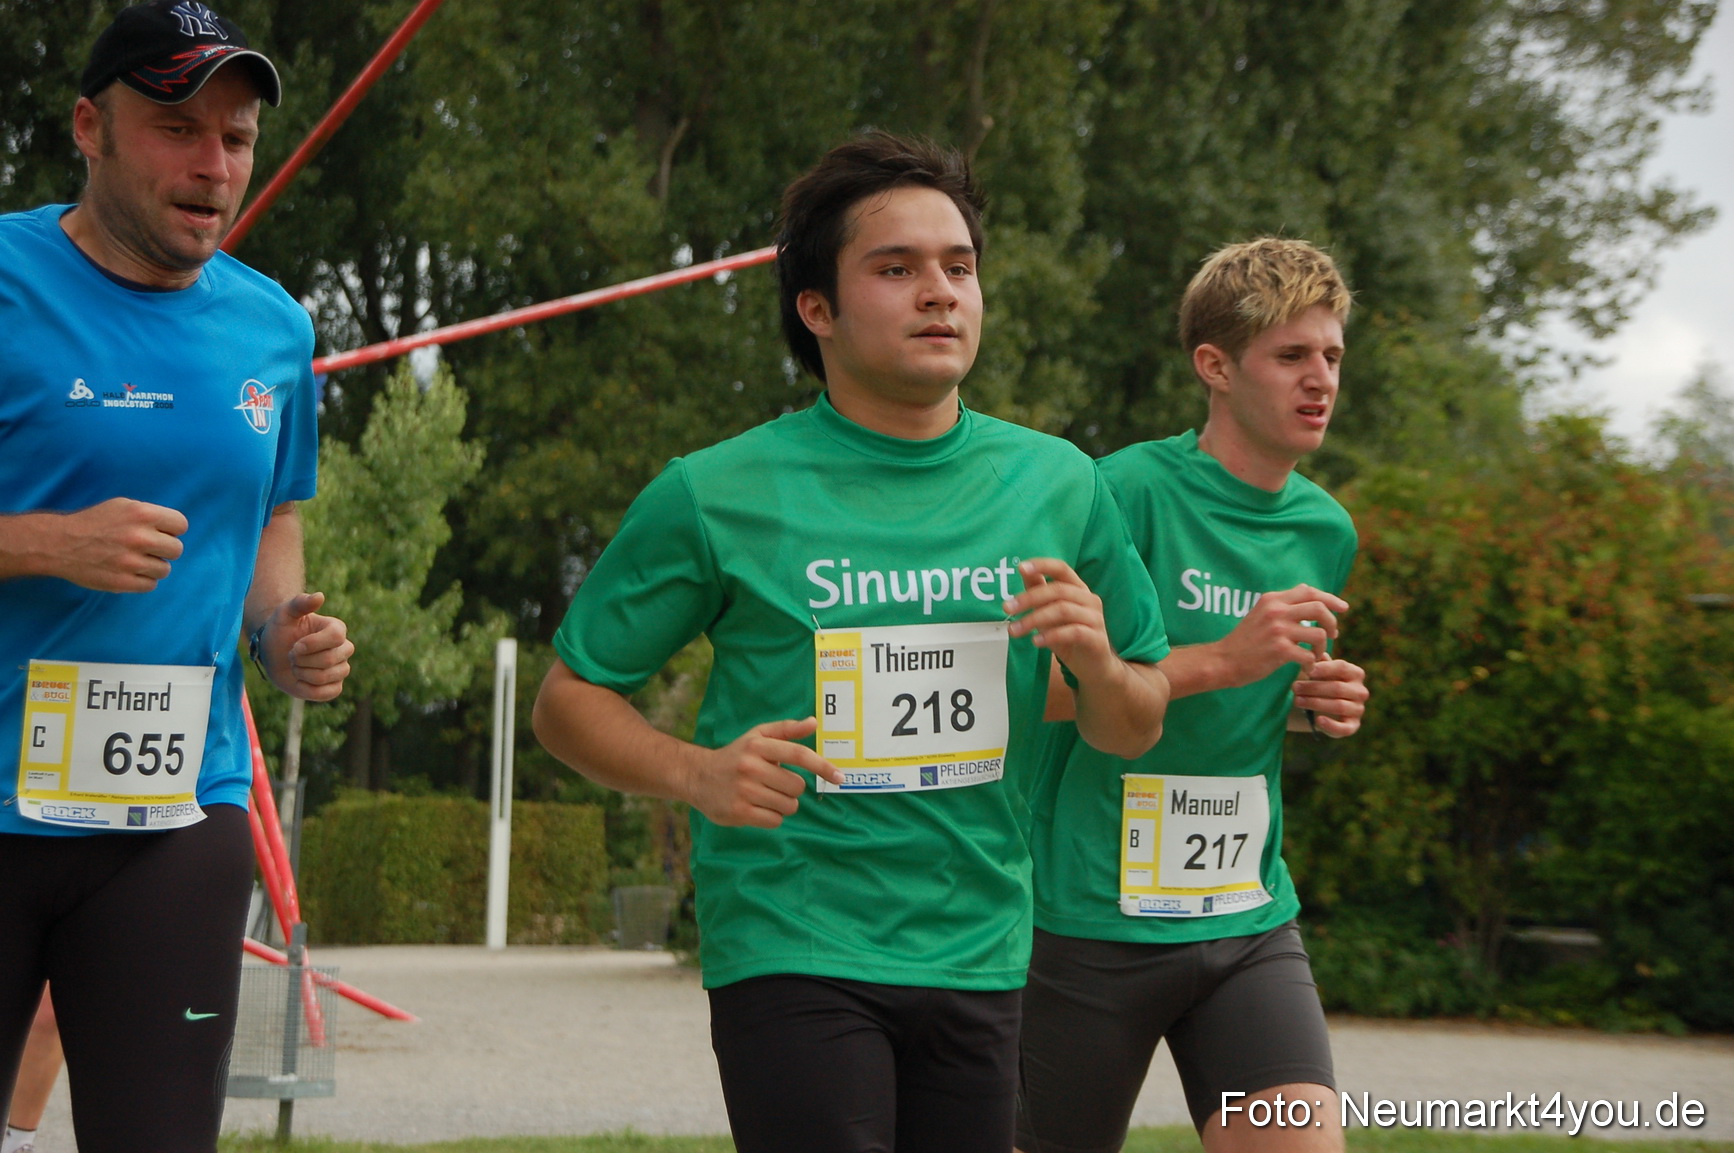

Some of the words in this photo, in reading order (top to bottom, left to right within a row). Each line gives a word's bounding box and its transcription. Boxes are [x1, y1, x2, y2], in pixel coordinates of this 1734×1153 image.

[1177, 568, 1262, 618] Sinu
[870, 643, 954, 673] Thiemo
[87, 679, 171, 711] Erhard
[825, 694, 836, 715] B
[891, 688, 975, 736] 218
[33, 726, 46, 747] C
[103, 732, 185, 775] 655
[940, 758, 1001, 777] PFLEIDERER
[41, 805, 96, 819] BOCK
[150, 802, 199, 818] PFLEIDERER
[1171, 789, 1239, 815] Manuel
[1130, 829, 1139, 848] B
[1183, 833, 1249, 870] 217
[1215, 889, 1265, 906] PFLEIDERER
